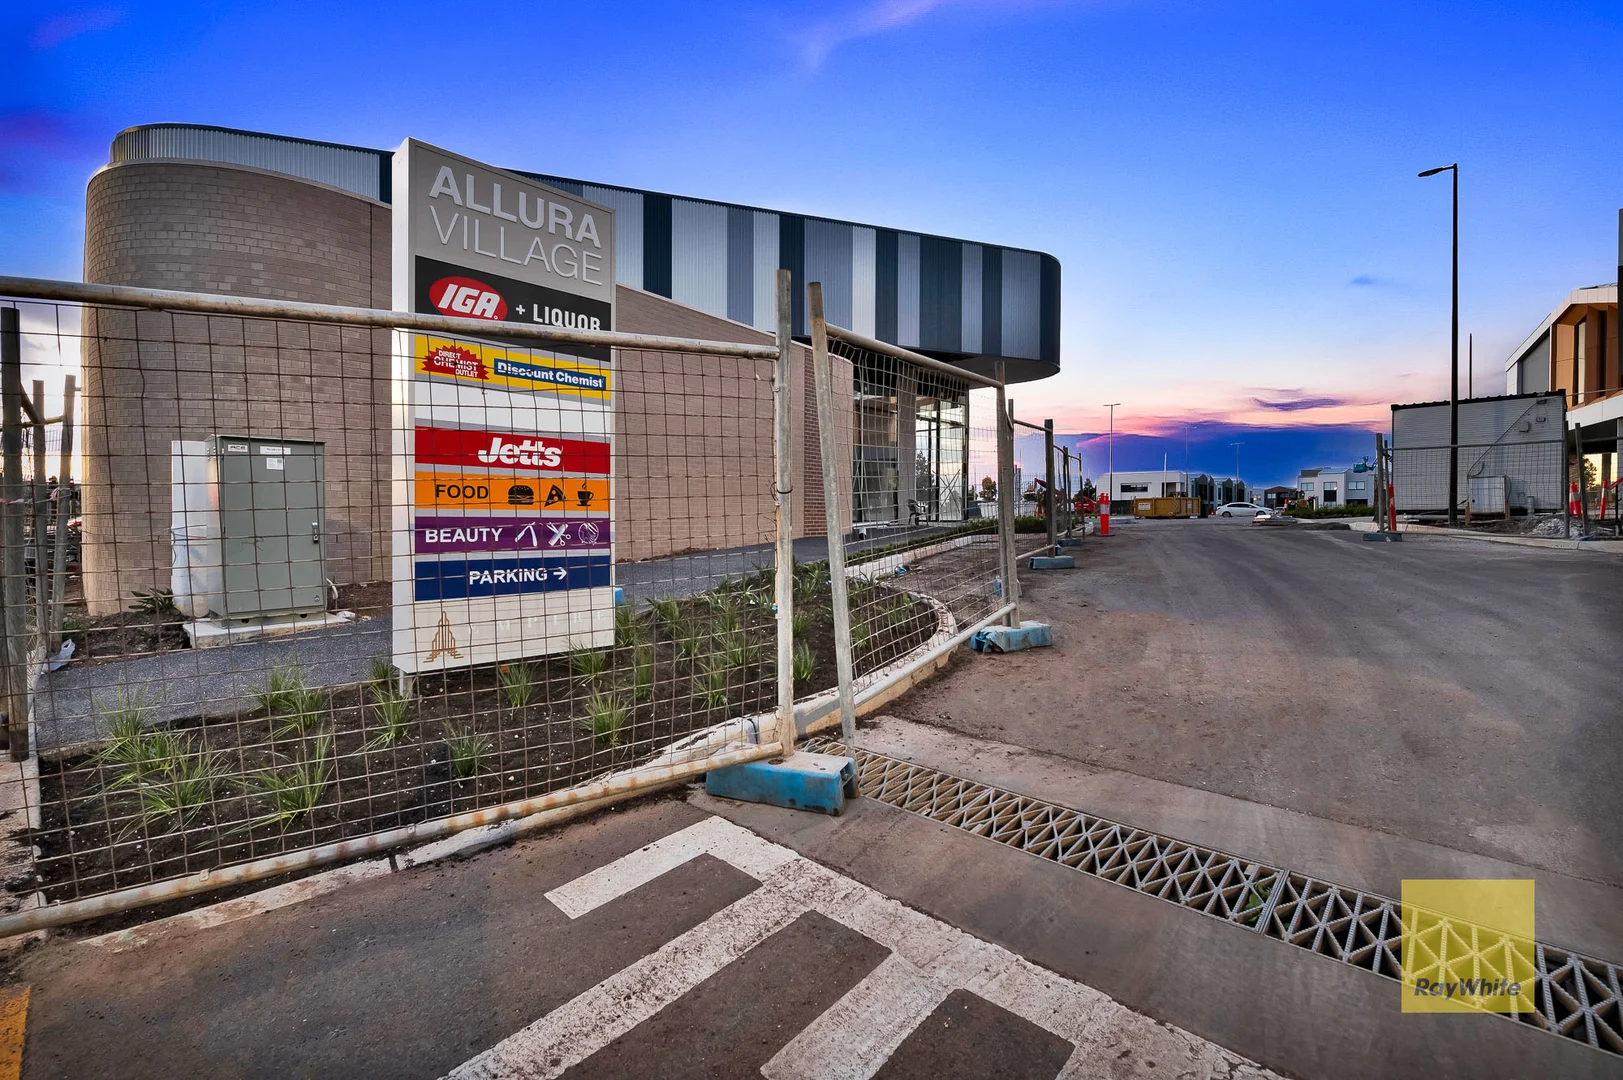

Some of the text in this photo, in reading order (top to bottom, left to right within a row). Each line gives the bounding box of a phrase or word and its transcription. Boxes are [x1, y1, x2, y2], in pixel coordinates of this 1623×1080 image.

[429, 165, 602, 249] ALLURA
[429, 205, 603, 287] VILLAGE
[438, 283, 500, 318] IGA
[533, 303, 601, 331] LIQUOR
[433, 355, 479, 371] CHEMIST
[438, 350, 461, 360] DIRECT
[455, 368, 479, 378] OUTLET
[497, 361, 603, 388] Discount Chemist
[477, 436, 562, 467] Jetts
[435, 484, 489, 499] FOOD
[425, 527, 503, 543] BEAUTY
[469, 567, 548, 585] PARKING
